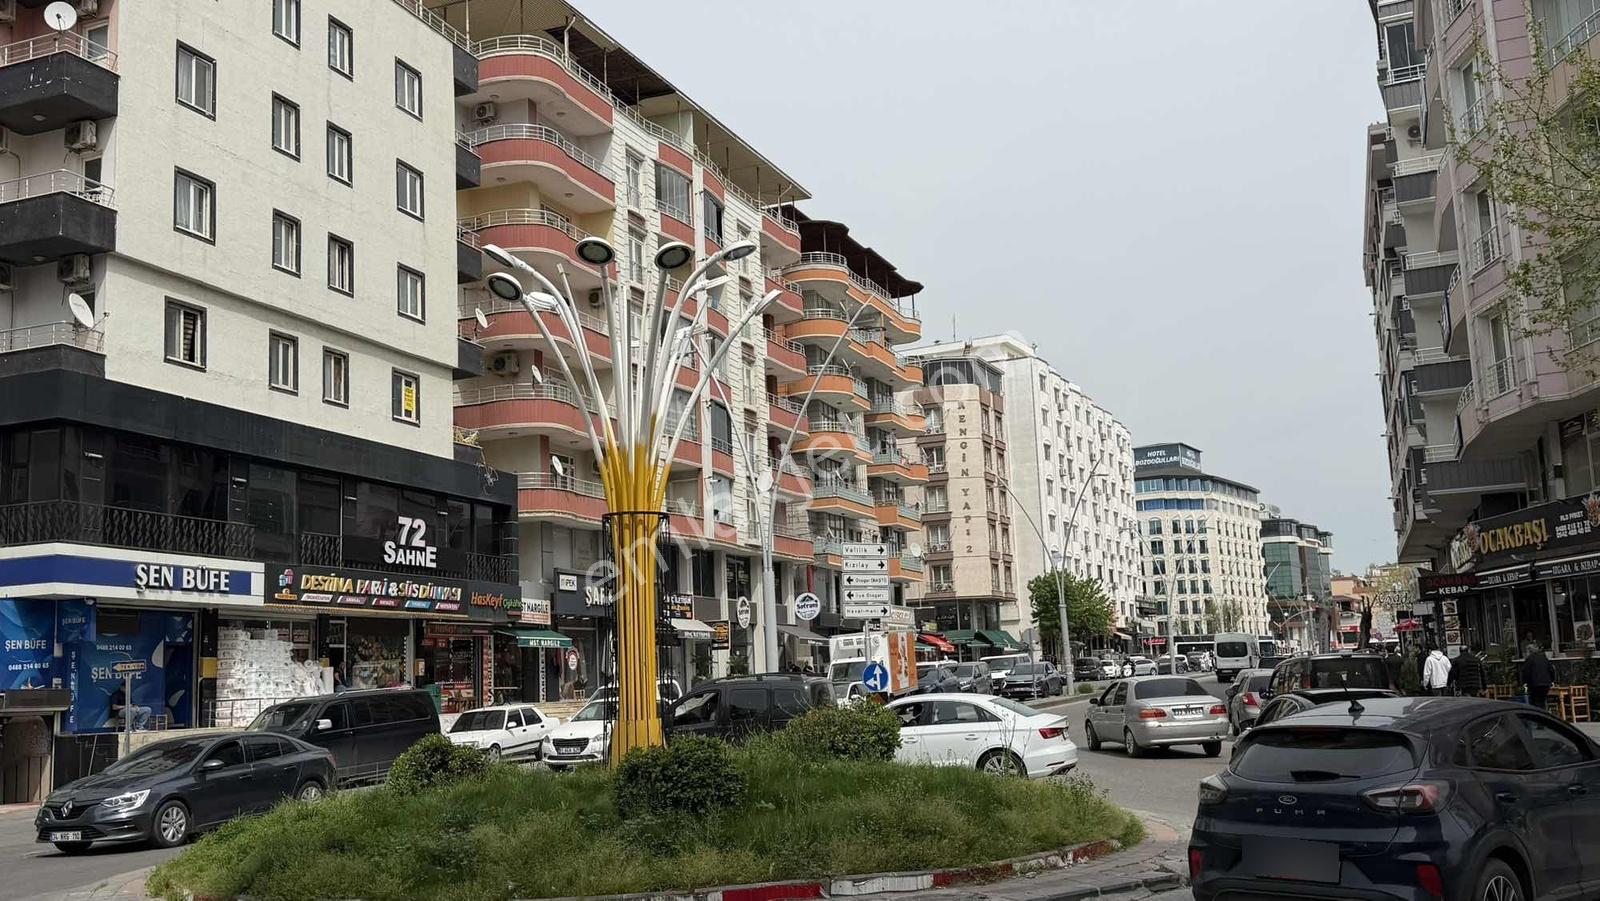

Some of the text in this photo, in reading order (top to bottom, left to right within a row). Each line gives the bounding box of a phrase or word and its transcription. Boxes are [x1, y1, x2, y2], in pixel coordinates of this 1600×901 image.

[398, 516, 426, 547] 72
[1479, 518, 1550, 555] OCAKBAŞI
[384, 540, 437, 568] SAHNE
[966, 545, 973, 553] 2
[136, 564, 230, 592] ŞEN BÜFE
[301, 573, 353, 593] DESTİNA
[1438, 585, 1469, 594] KEBAP
[5, 638, 47, 652] ŞEN BÜFE
[91, 666, 111, 682] ŞEN
